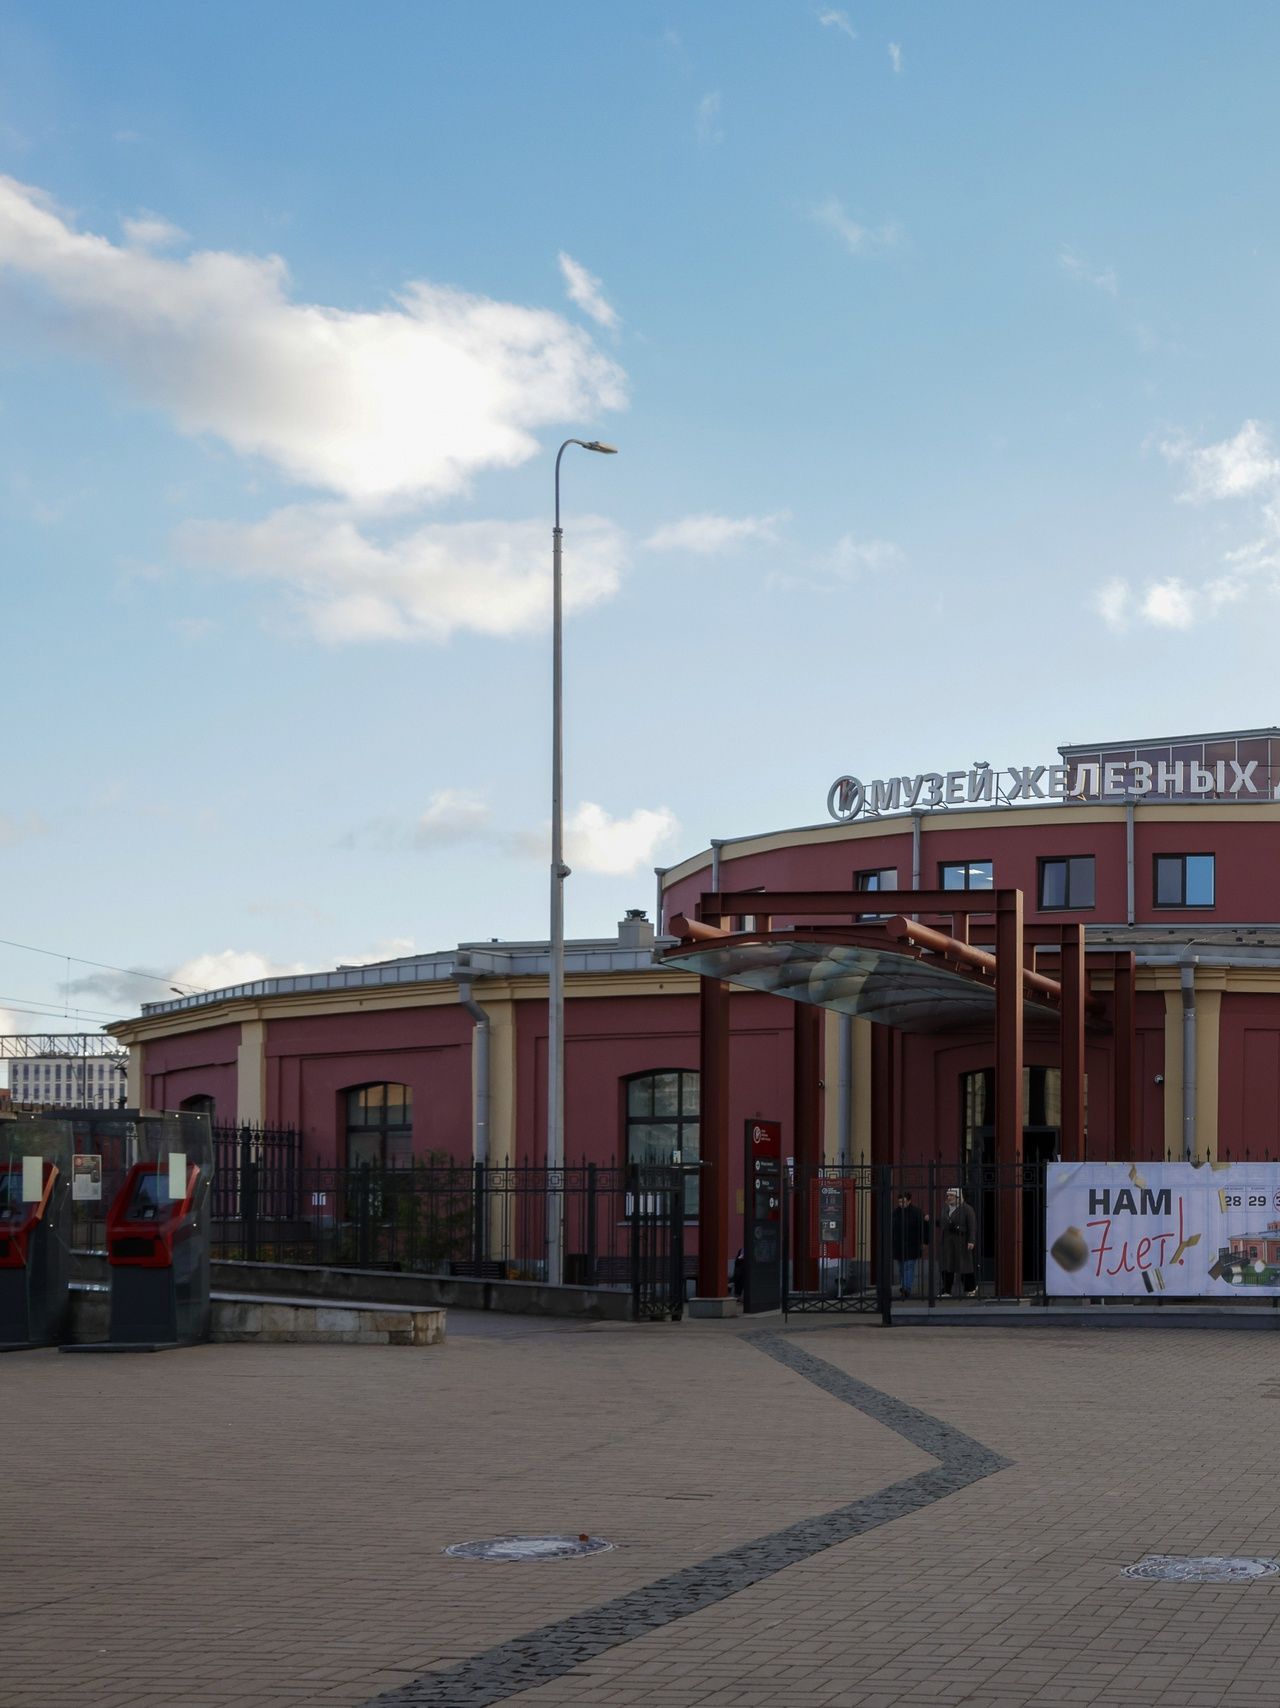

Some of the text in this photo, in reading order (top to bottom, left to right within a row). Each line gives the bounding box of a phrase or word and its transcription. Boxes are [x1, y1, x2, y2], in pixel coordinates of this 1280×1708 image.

[871, 761, 991, 811] МУЗЕЙ
[1006, 760, 1259, 800] ЖЕЛЕЗНЫХ
[1088, 1188, 1172, 1216] НАМ
[1225, 1195, 1242, 1207] 28
[1248, 1195, 1267, 1207] 29
[1086, 1219, 1113, 1278] 7
